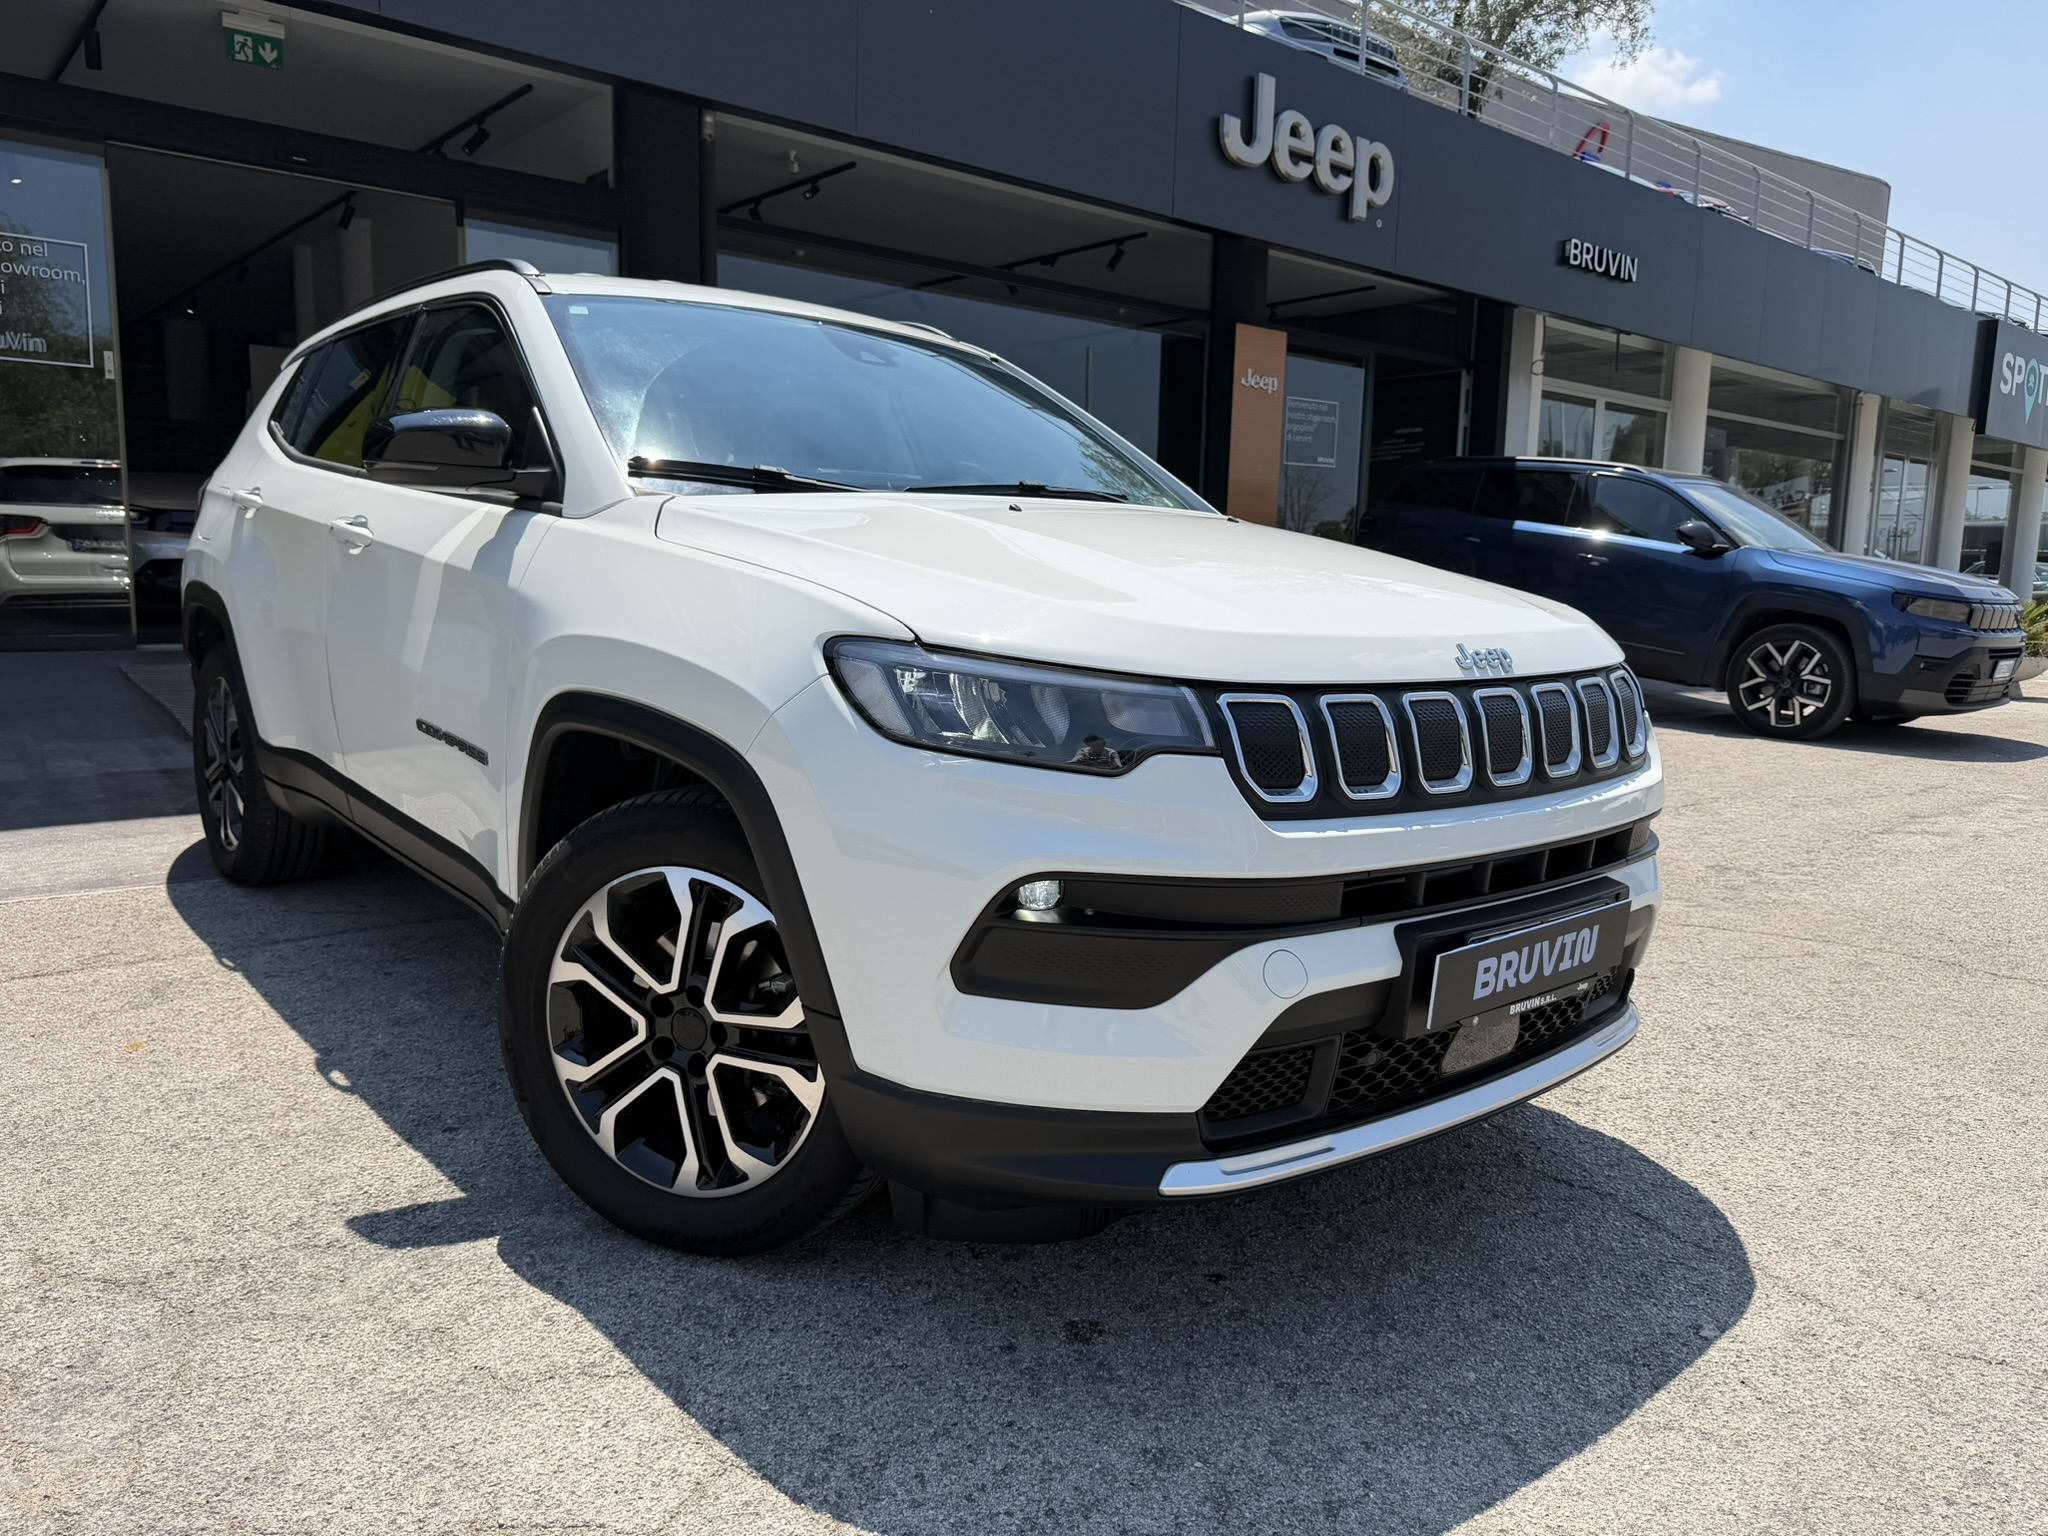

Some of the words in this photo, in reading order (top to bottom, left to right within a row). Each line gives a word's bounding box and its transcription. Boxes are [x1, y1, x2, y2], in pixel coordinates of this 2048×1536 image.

[1219, 72, 1395, 221] Jeep
[0, 240, 14, 252] o
[20, 242, 48, 257] nel
[1568, 238, 1638, 282] BRUVIN
[1241, 368, 1278, 394] Jeep
[2000, 352, 2048, 424] SPOT
[1455, 642, 1513, 673] Jeep
[1473, 924, 1600, 1000] BRUVIN
[1509, 997, 1540, 1015] BRUVIN
